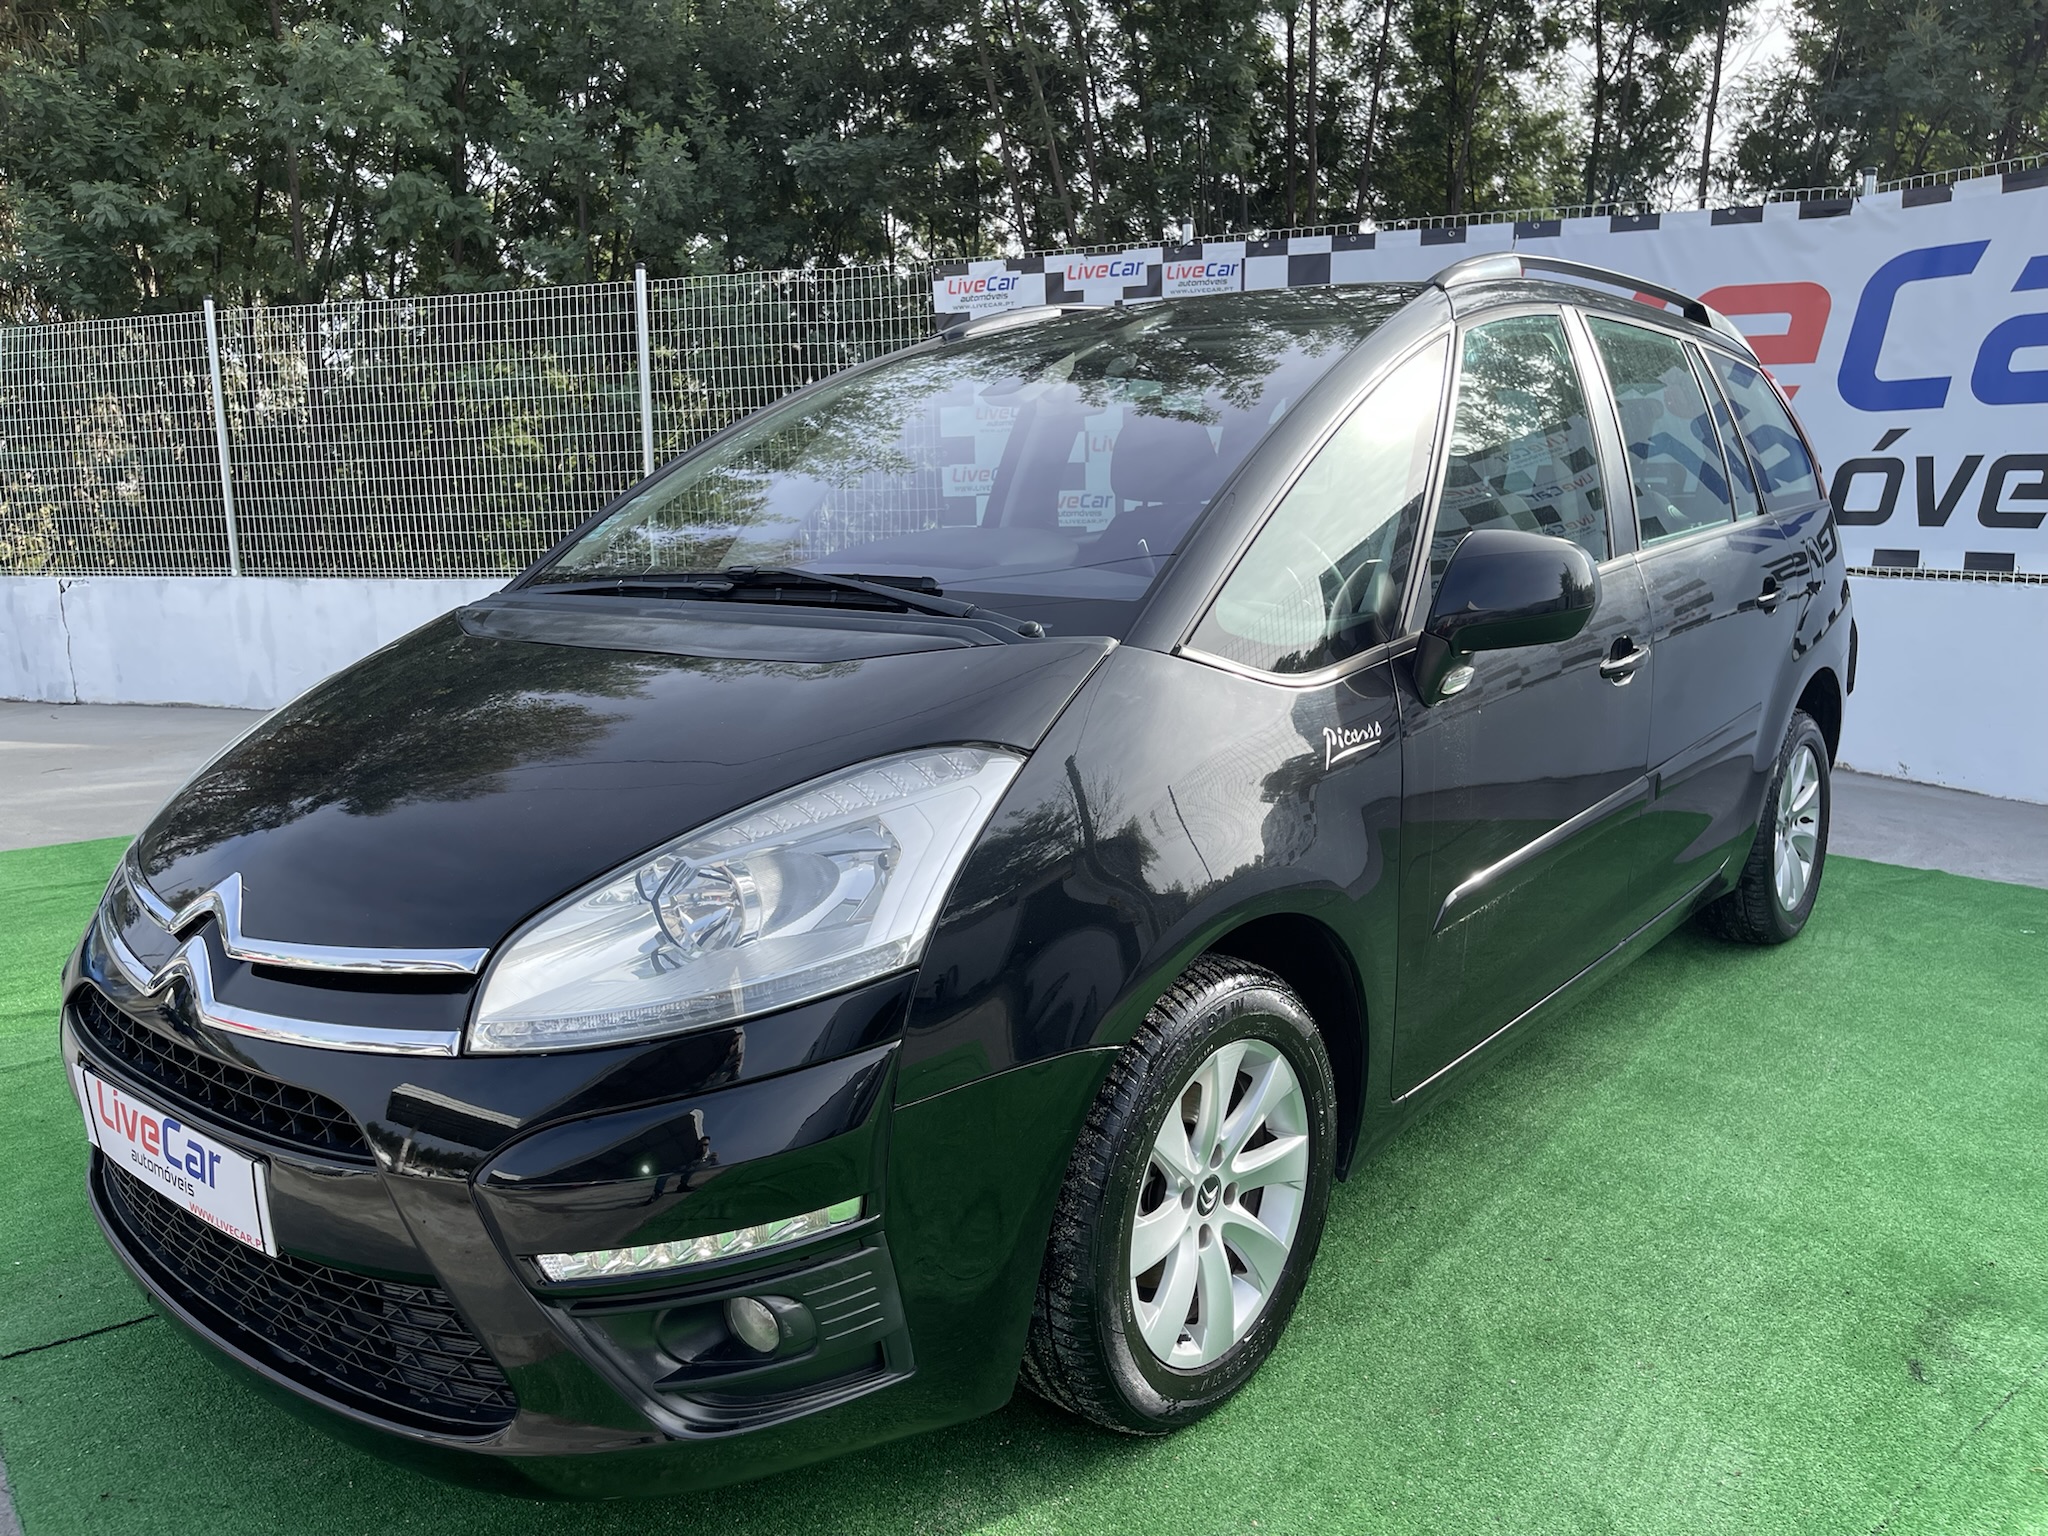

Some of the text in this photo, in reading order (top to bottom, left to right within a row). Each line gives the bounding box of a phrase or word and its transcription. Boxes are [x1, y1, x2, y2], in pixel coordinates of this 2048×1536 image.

[948, 275, 1020, 295] LiveCar
[1067, 260, 1144, 280] LiveCar
[1166, 262, 1239, 280] LiveCar
[1322, 721, 1382, 771] Picasso
[96, 1080, 221, 1189] LiveCar
[131, 1149, 195, 1197] automóveis
